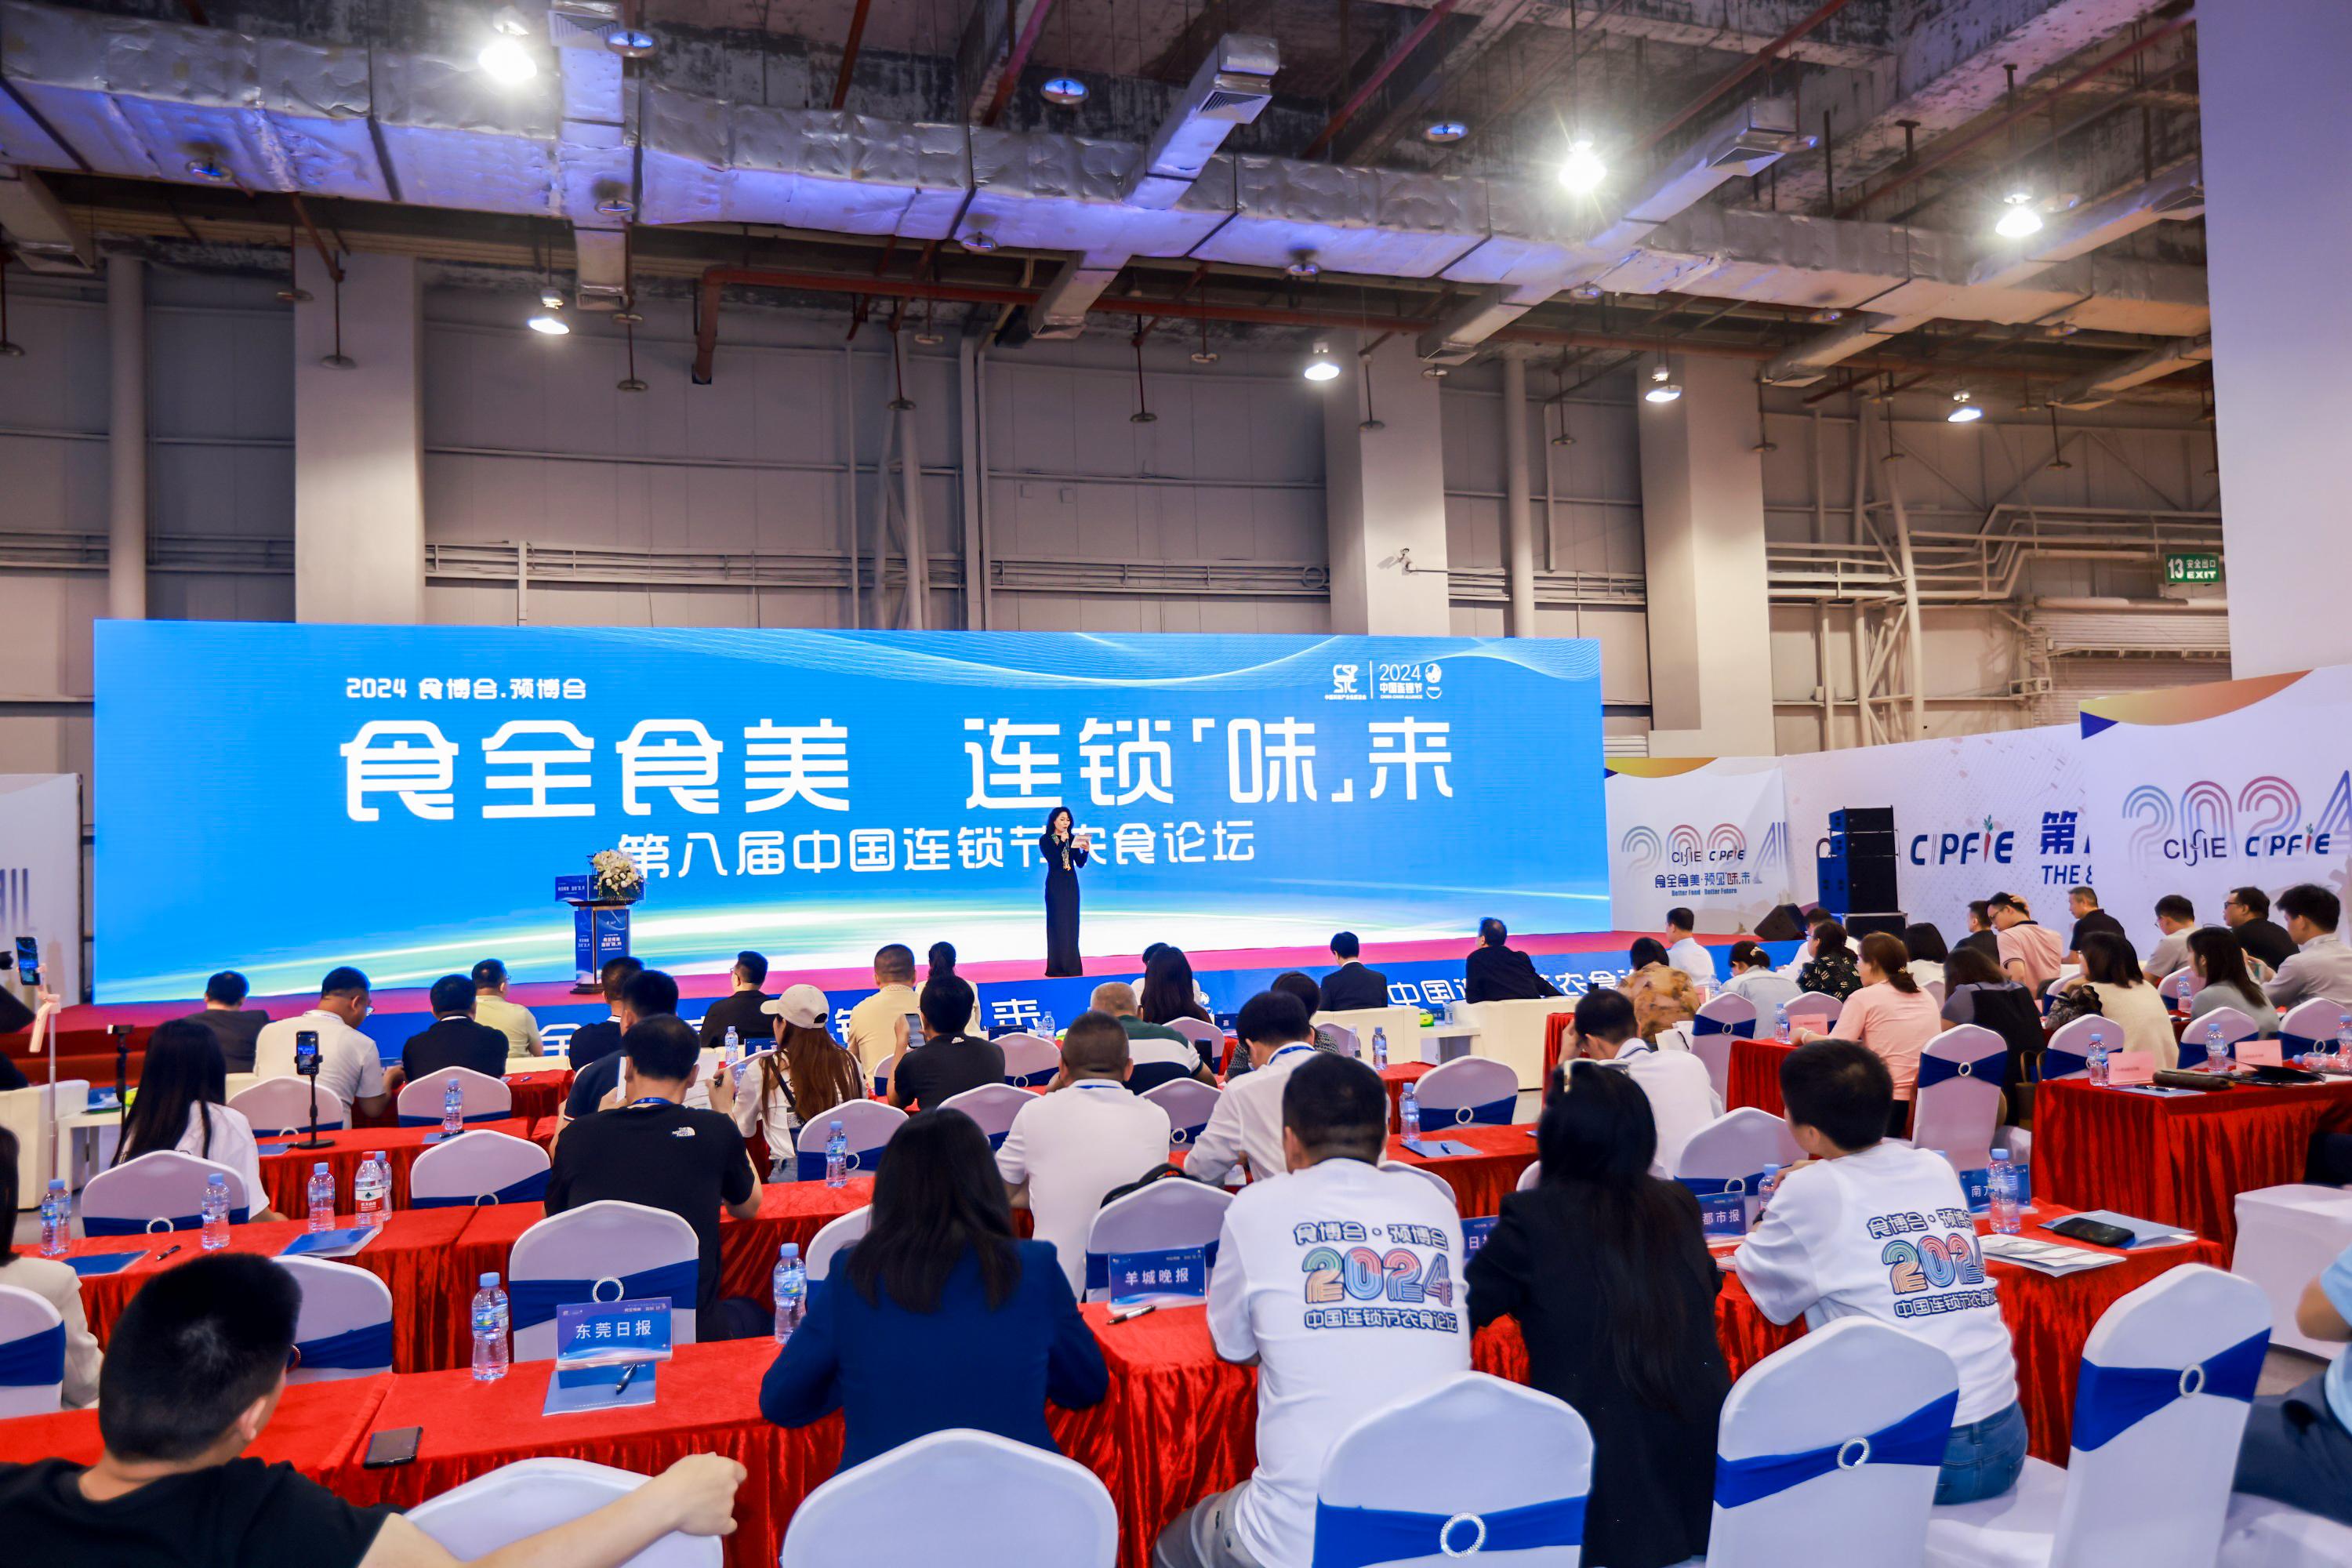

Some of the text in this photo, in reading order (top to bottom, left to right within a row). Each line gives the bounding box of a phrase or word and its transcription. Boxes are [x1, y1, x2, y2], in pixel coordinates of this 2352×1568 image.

[2168, 558, 2183, 579] 13
[2187, 559, 2216, 568] 安全出口
[2187, 570, 2216, 579] EXIT
[1379, 663, 1421, 681] 2024
[347, 677, 407, 699] 2024
[340, 718, 850, 822] 食全食美
[2042, 865, 2080, 885] THE
[1125, 1268, 1189, 1286] 羊城晚报
[1302, 1247, 1453, 1307] 2024
[575, 1319, 652, 1339] 东莞日报
[1304, 1308, 1458, 1333] 中国连锁节农食论坛
